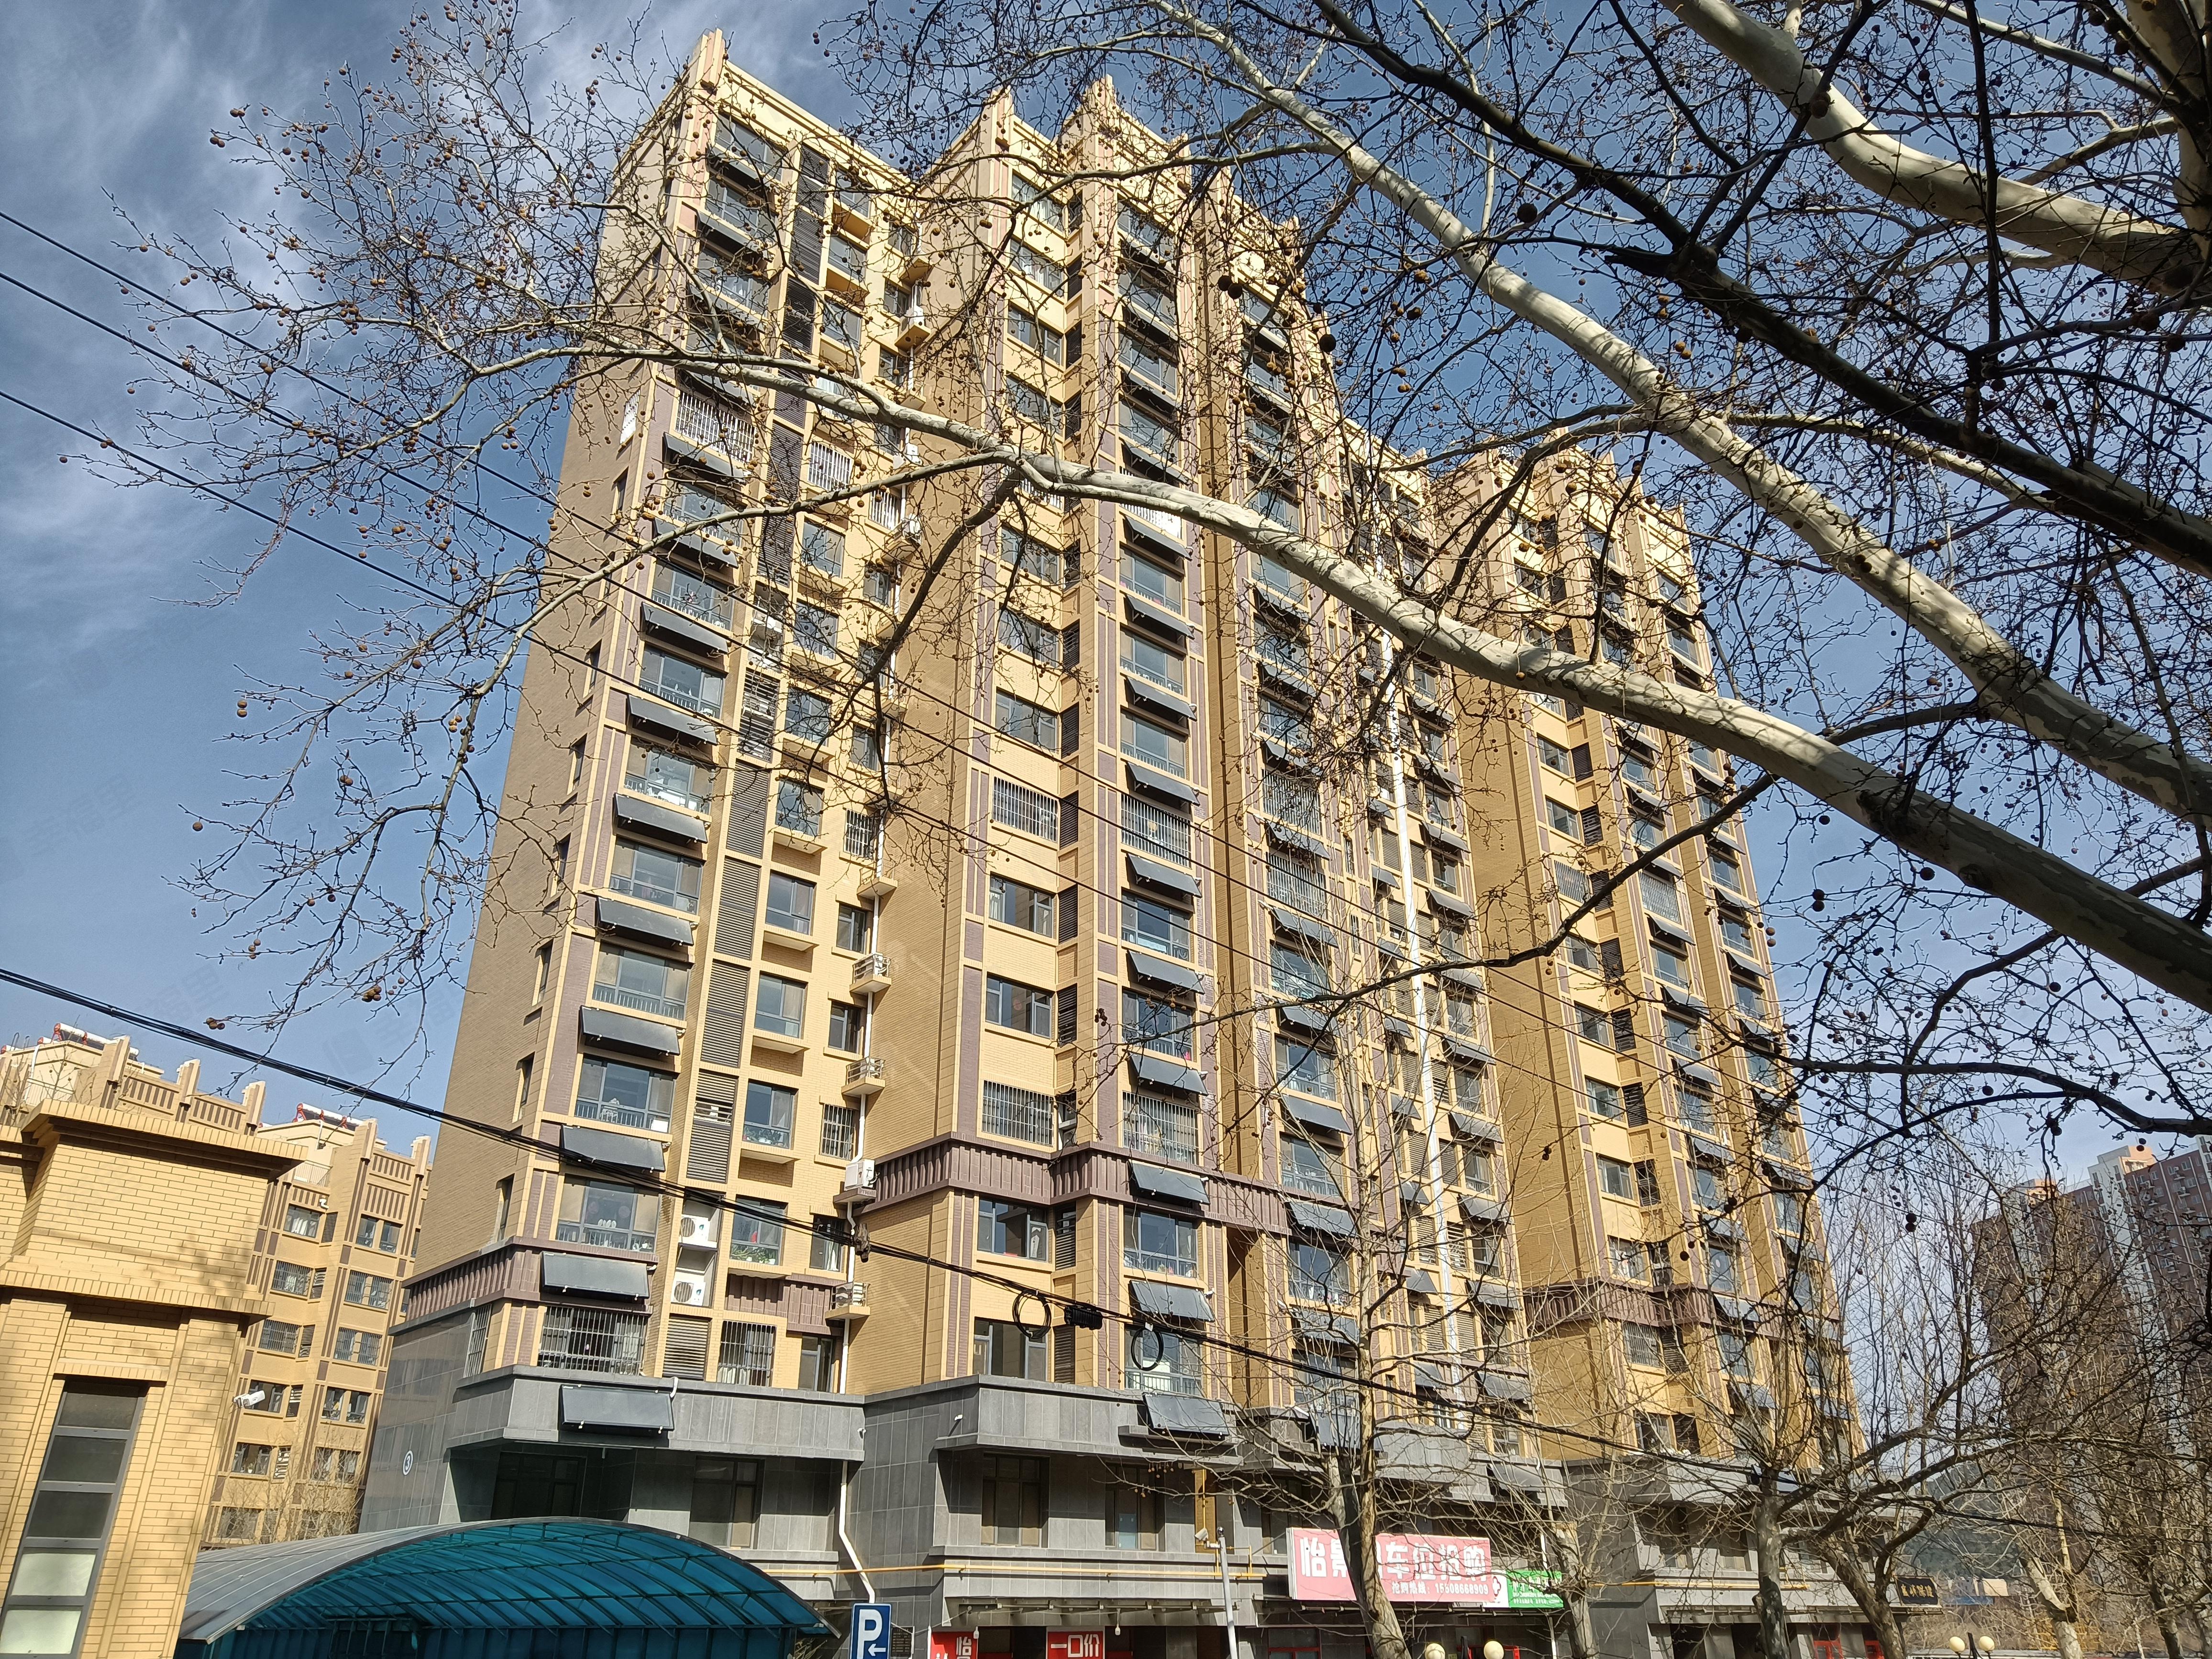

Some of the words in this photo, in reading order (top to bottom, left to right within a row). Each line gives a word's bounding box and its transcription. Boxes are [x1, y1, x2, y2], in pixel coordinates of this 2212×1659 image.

[1300, 1537, 1487, 1582] 怡景车位抢购
[857, 1609, 883, 1659] P
[956, 1636, 972, 1659] 怡
[1051, 1634, 1100, 1658] 一口价
